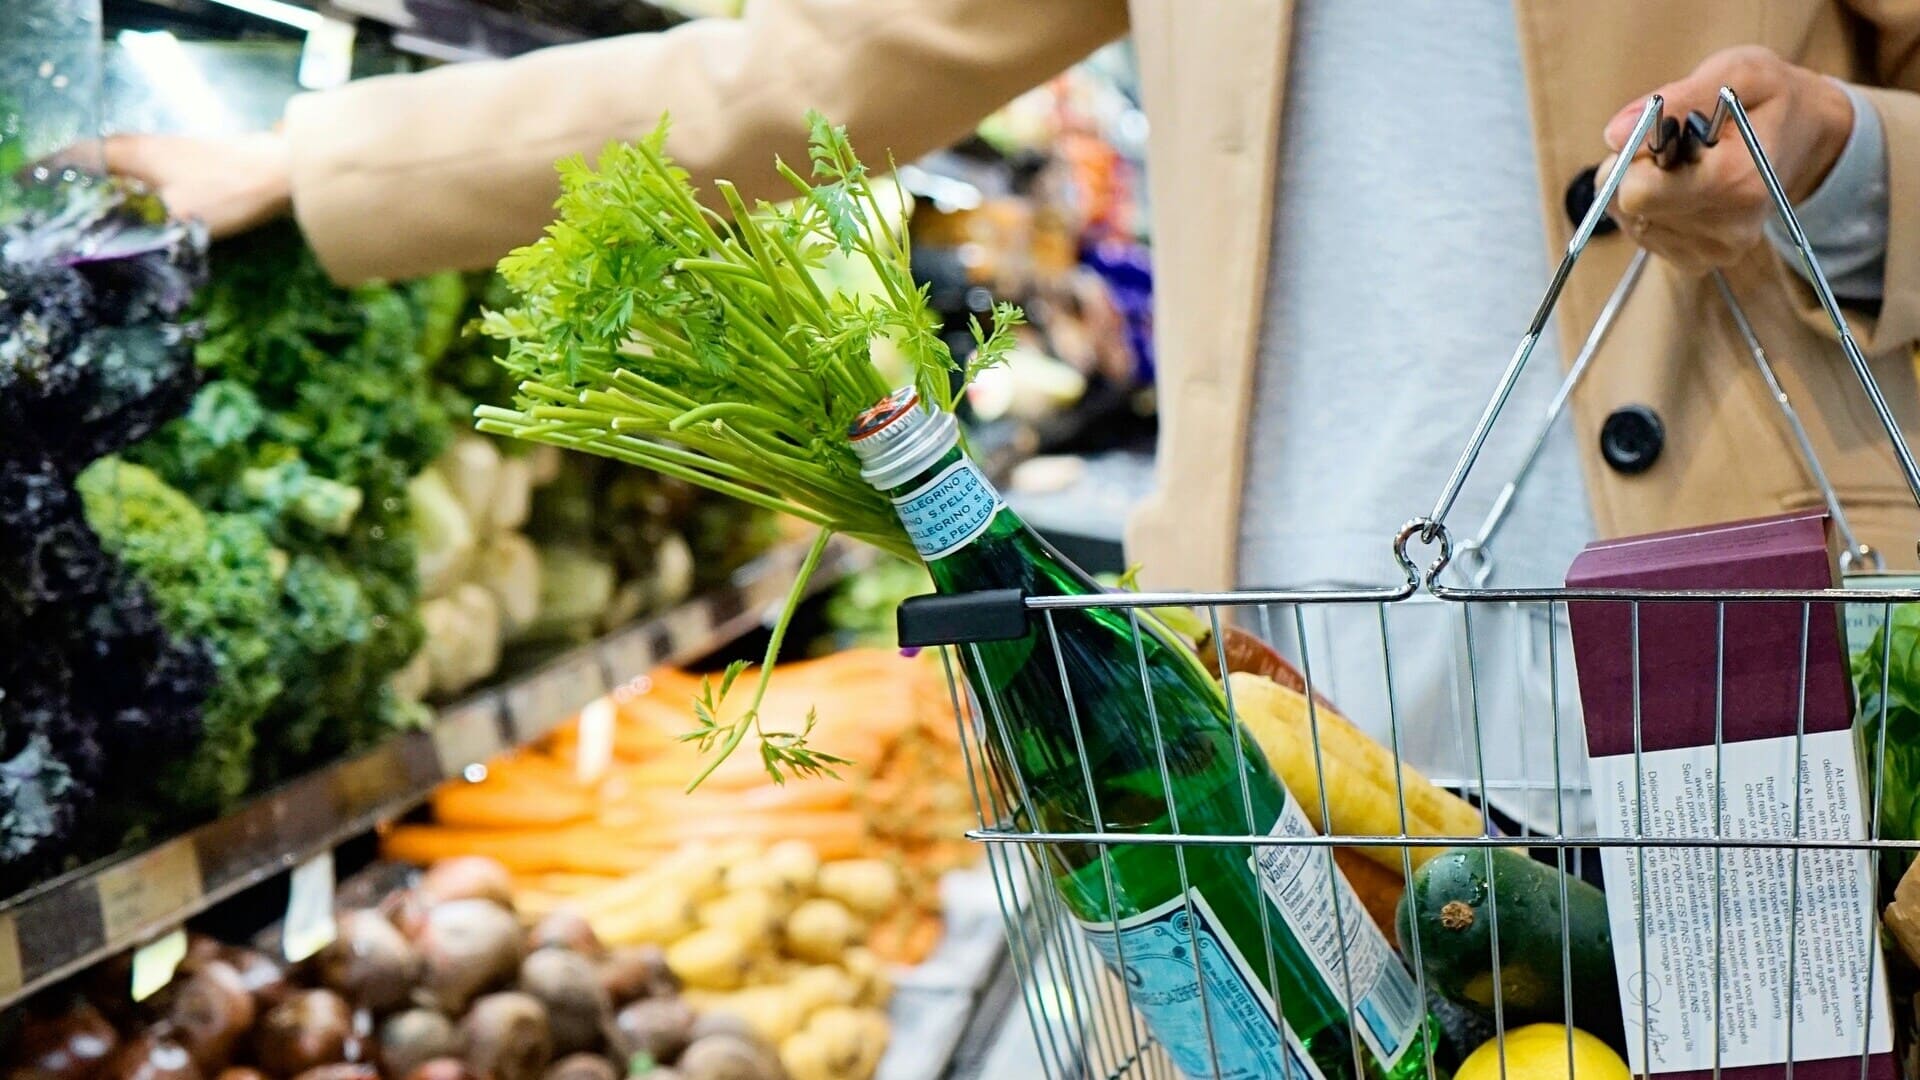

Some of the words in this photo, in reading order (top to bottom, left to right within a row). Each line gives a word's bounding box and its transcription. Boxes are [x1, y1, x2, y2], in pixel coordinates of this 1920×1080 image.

[1681, 762, 1693, 784] Seul
[1704, 767, 1714, 780] de
[1798, 753, 1811, 785] Lesley
[1822, 758, 1836, 800] delicious
[1834, 766, 1844, 778] At
[1617, 780, 1626, 803] vous
[1647, 770, 1661, 813] Délicieux
[1684, 786, 1692, 798] un
[1694, 776, 1704, 799] avec
[1743, 782, 1756, 818] cheese
[1755, 782, 1765, 797] but
[1765, 775, 1776, 802] these
[1804, 786, 1813, 794] &
[1834, 779, 1849, 811] Lesley
[1620, 804, 1628, 817] ne
[1684, 800, 1699, 834] produit
[1696, 800, 1708, 822] soin,
[1755, 800, 1768, 825] really
[1805, 796, 1815, 814] her
[1817, 809, 1826, 825] are
[1827, 802, 1839, 825] food.
[1637, 788, 1654, 854] accompags
[1653, 815, 1661, 828] au
[1673, 794, 1690, 848] supérieu
[1721, 813, 1734, 842] Stow
[1737, 817, 1747, 842] snac
[1748, 820, 1756, 829] or
[1767, 804, 1781, 837] unique
[1807, 815, 1819, 841] team
[1620, 819, 1633, 856] pouez
[1653, 830, 1668, 865] nurel,
[1663, 808, 1679, 862] CRAEZ
[1760, 827, 1772, 852] she
[1798, 830, 1809, 853] frm
[1820, 827, 1830, 855] mae
[1831, 828, 1843, 856] The
[1648, 855, 1657, 867] de
[1680, 847, 1695, 881] pouvait
[1691, 835, 1704, 869] aison
[1703, 843, 1714, 871] etites
[1741, 847, 1752, 868] food
[1773, 843, 1786, 878] ackers
[1811, 841, 1822, 865] ink
[1844, 846, 1856, 866] ine
[1266, 853, 1292, 883] Valeur
[1624, 856, 1636, 877] plus
[1660, 867, 1668, 884] ces
[1670, 862, 1683, 893] POUR
[1744, 870, 1753, 878] &
[1764, 855, 1775, 880] when
[1779, 800, 1790, 809] A
[1786, 853, 1806, 936] RSATION
[1801, 855, 1814, 889] scratch
[1814, 867, 1824, 884] the
[1823, 856, 1834, 876] with
[1694, 871, 1709, 910] fabriqué
[1728, 868, 1741, 898] Foods
[1745, 880, 1754, 895] are
[1756, 877, 1765, 894] We
[1778, 880, 1787, 895] are
[1826, 878, 1835, 899] care
[1835, 859, 1848, 899] fabulous
[1847, 868, 1860, 898] Foods
[1629, 879, 1639, 905] vous
[1648, 870, 1663, 917] trempette,
[1686, 882, 1700, 925] satisfaire
[1758, 896, 1767, 913] are
[1766, 882, 1780, 915] topped
[1804, 891, 1817, 916] using
[1814, 884, 1827, 903] only
[1660, 885, 1677, 934] craquelins
[1674, 895, 1686, 918] CES
[1719, 888, 1733, 927] fabuleux
[1732, 899, 1744, 927] adore
[1747, 897, 1757, 918] sure
[1779, 898, 1792, 923] great
[1817, 906, 1828, 925] way
[1829, 901, 1838, 910] in
[1838, 900, 1852, 929] crisps
[1851, 900, 1859, 915] we
[1643, 912, 1654, 938] nous,
[1656, 918, 1665, 931] de
[1677, 919, 1690, 944] FINS
[1701, 912, 1710, 934] avec
[1748, 920, 1759, 938] you
[1760, 914, 1773, 953] addicted
[1772, 917, 1782, 936] with
[1809, 918, 1818, 934] our
[1822, 927, 1831, 936] to
[1830, 912, 1842, 938] small
[1853, 916, 1865, 936] love
[1656, 933, 1670, 972] fromage
[1668, 935, 1680, 956] sont
[1690, 926, 1704, 956] Lesley
[1704, 935, 1714, 953] des
[1723, 929, 1739, 978] craquelins
[1734, 928, 1750, 970] fabriquer
[1753, 939, 1763, 954] will
[1773, 937, 1783, 958] your
[1812, 936, 1823, 961] finest
[1823, 938, 1834, 964] make
[1844, 930, 1855, 953] from
[1696, 958, 1706, 968] et
[1755, 957, 1765, 969] be
[1766, 956, 1775, 966] to
[1834, 940, 1847, 980] batches.
[1854, 937, 1869, 972] making
[1663, 974, 1671, 986] ou
[1671, 957, 1687, 1009] irrésistibles
[1681, 945, 1699, 1014] CRAQUELINS
[1698, 970, 1707, 988] son
[1741, 971, 1751, 981] et
[1757, 971, 1767, 988] too.
[1767, 967, 1777, 984] this
[1845, 954, 1860, 992] Lesley's
[1722, 991, 1731, 1004] de
[1731, 979, 1742, 1000] sont
[1743, 983, 1752, 1006] vous
[1791, 981, 1802, 1000] their
[1813, 963, 1830, 1016] ingredients.
[1826, 975, 1839, 1000] great
[1698, 989, 1713, 1024] équipe.
[1768, 985, 1780, 1021] yummy
[1794, 1003, 1803, 1023] own
[1852, 993, 1865, 1028] kitchen
[1722, 1006, 1736, 1038] Lesley.
[1732, 1001, 1748, 1045] fabriqués
[1746, 1007, 1758, 1029] offrir
[1829, 1001, 1844, 1037] product
